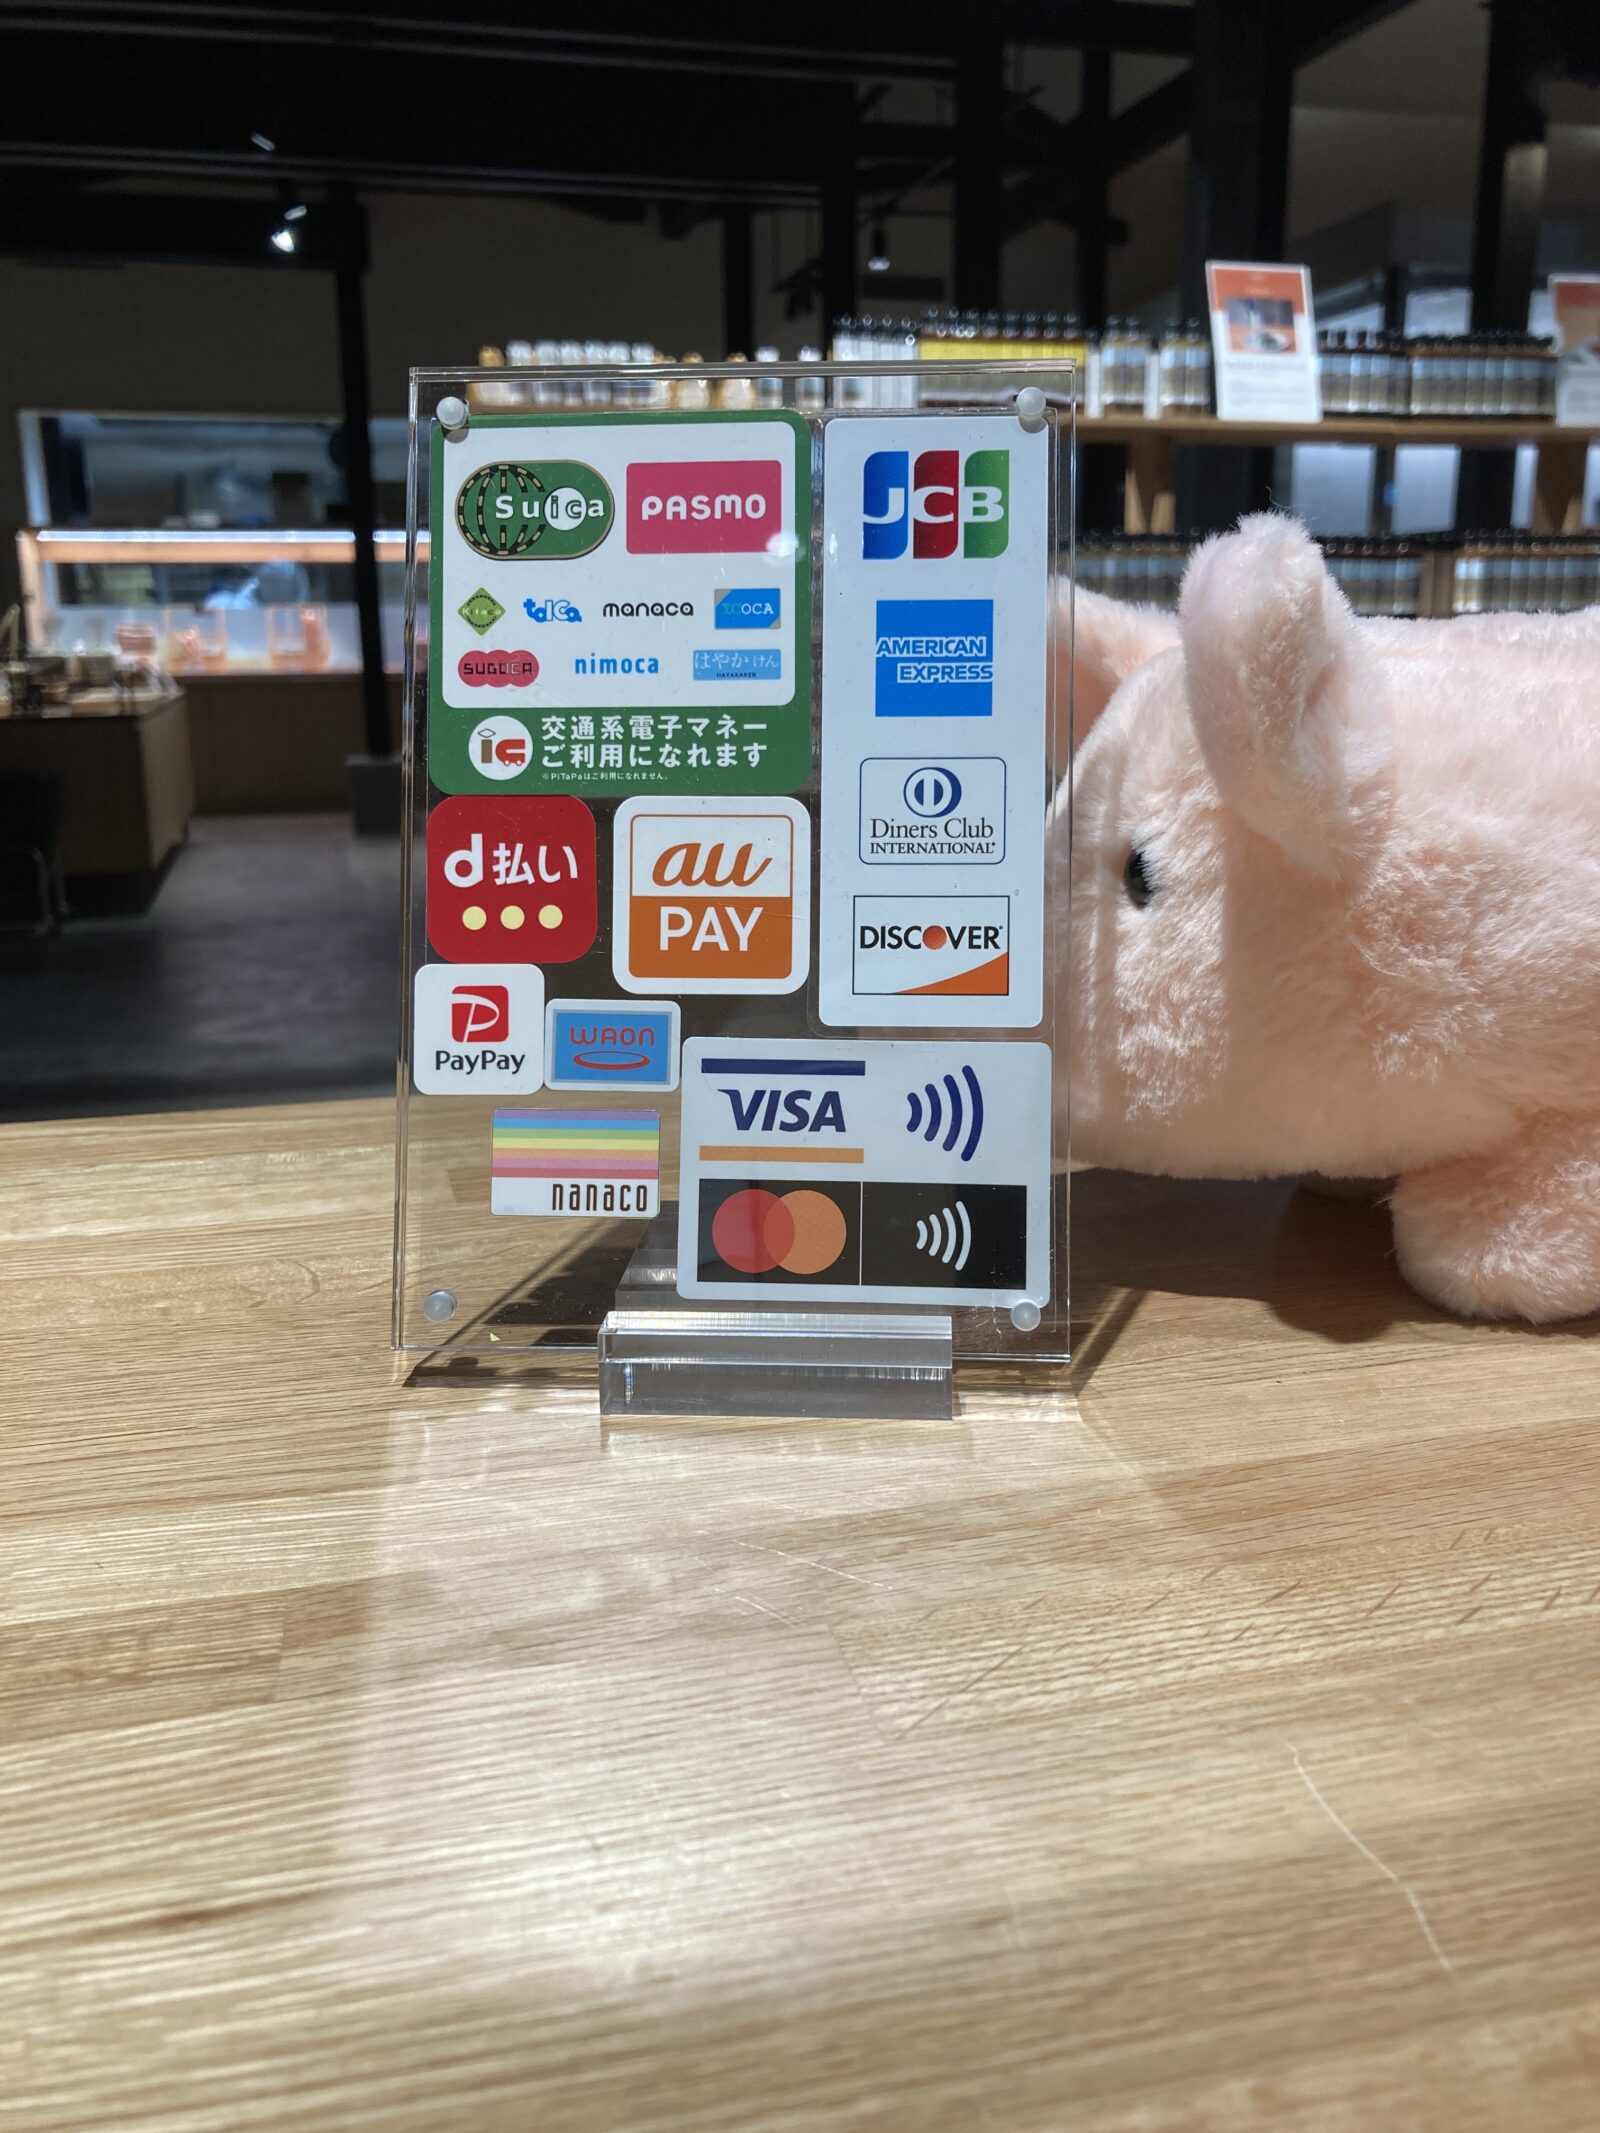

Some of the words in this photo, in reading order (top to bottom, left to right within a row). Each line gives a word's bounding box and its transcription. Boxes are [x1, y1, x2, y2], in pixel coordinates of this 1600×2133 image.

[495, 495, 605, 519] Suica
[641, 494, 766, 520] PASMO
[862, 486, 1004, 525] JCB
[462, 606, 502, 616] Kitaca
[602, 602, 694, 617] manaca
[722, 602, 774, 615] ICOCA
[876, 637, 985, 657] AMERICAN
[463, 662, 533, 675] SUGOCA
[575, 652, 659, 674] nimoca
[694, 652, 778, 669] はやかけん
[899, 664, 993, 683] EXPRESS
[541, 715, 767, 740] 交通系電子マネー
[541, 743, 767, 768] ご利用になれます
[870, 818, 939, 839] Diners
[943, 816, 993, 838] Club
[444, 834, 578, 888] d払い
[652, 843, 772, 887] au
[660, 906, 763, 951] PAY
[860, 925, 1002, 951] DISCOVER
[569, 1026, 655, 1046] WAON
[435, 1050, 525, 1075] PayPay
[717, 1089, 846, 1133] VISA
[552, 1183, 648, 1212] nanaco
